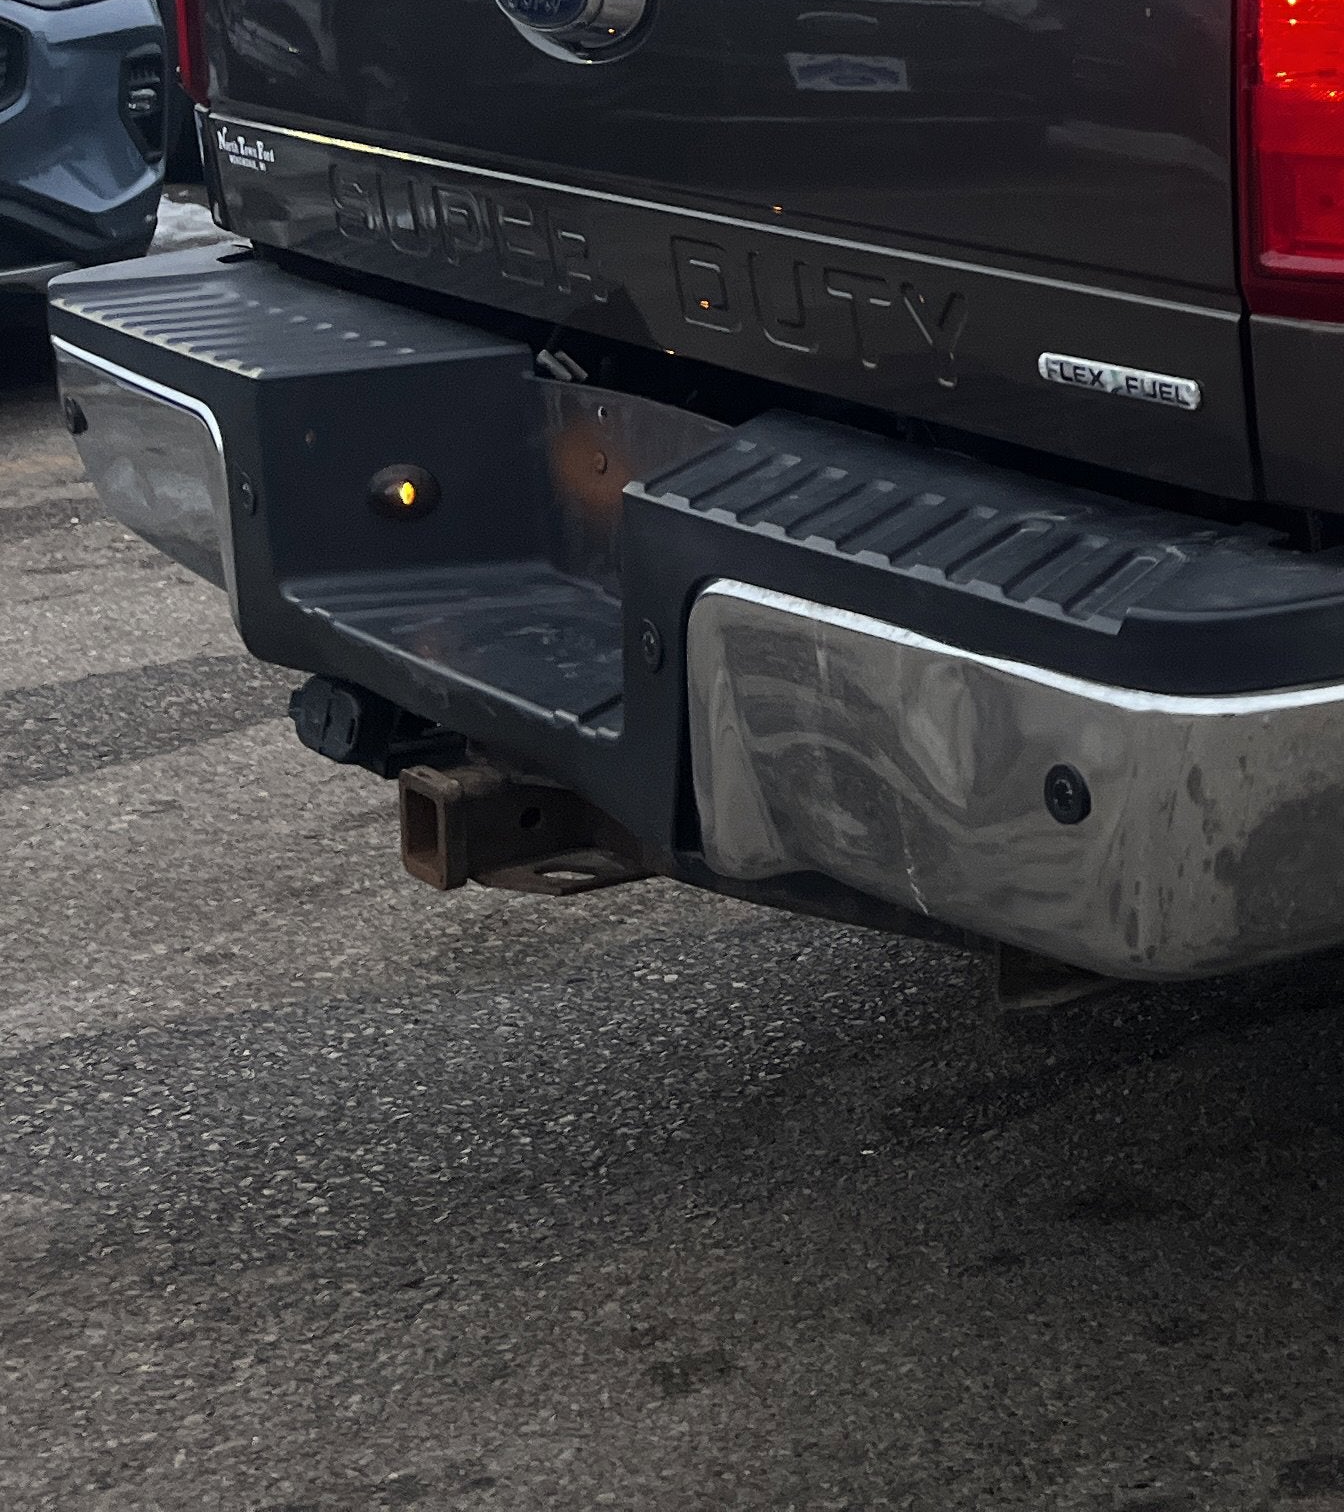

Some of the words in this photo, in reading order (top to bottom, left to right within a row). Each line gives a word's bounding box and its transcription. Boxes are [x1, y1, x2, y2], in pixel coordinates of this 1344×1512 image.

[329, 164, 612, 303] SUPER
[670, 235, 968, 388] DUTY
[1045, 357, 1106, 387] FLEX
[1124, 376, 1191, 406] FUEL
